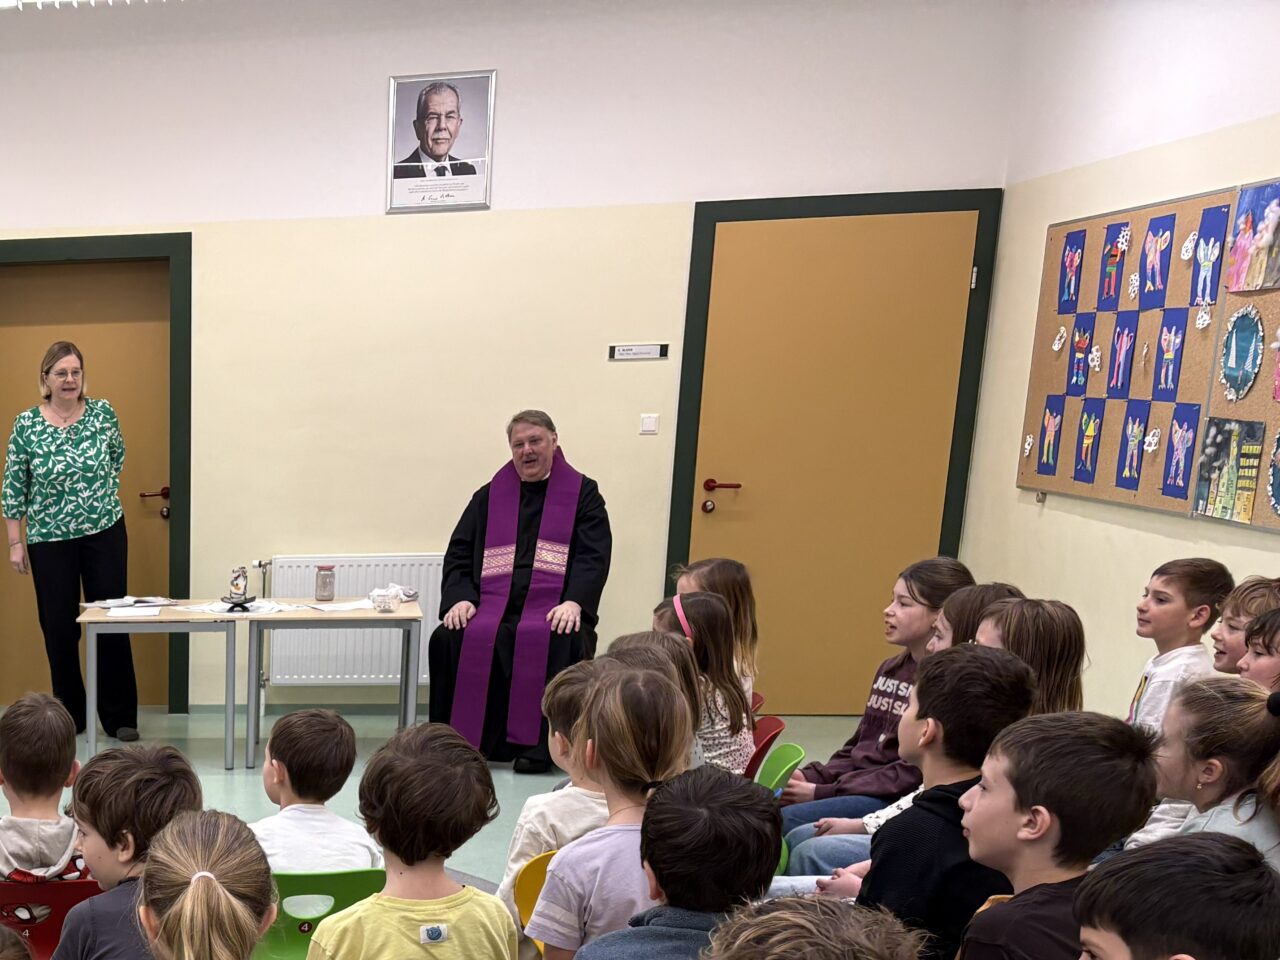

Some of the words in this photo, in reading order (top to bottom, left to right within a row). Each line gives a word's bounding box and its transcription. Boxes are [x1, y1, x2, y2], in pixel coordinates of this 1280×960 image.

[873, 676, 899, 693] JUST
[867, 694, 894, 712] JUST
[22, 929, 30, 937] 4
